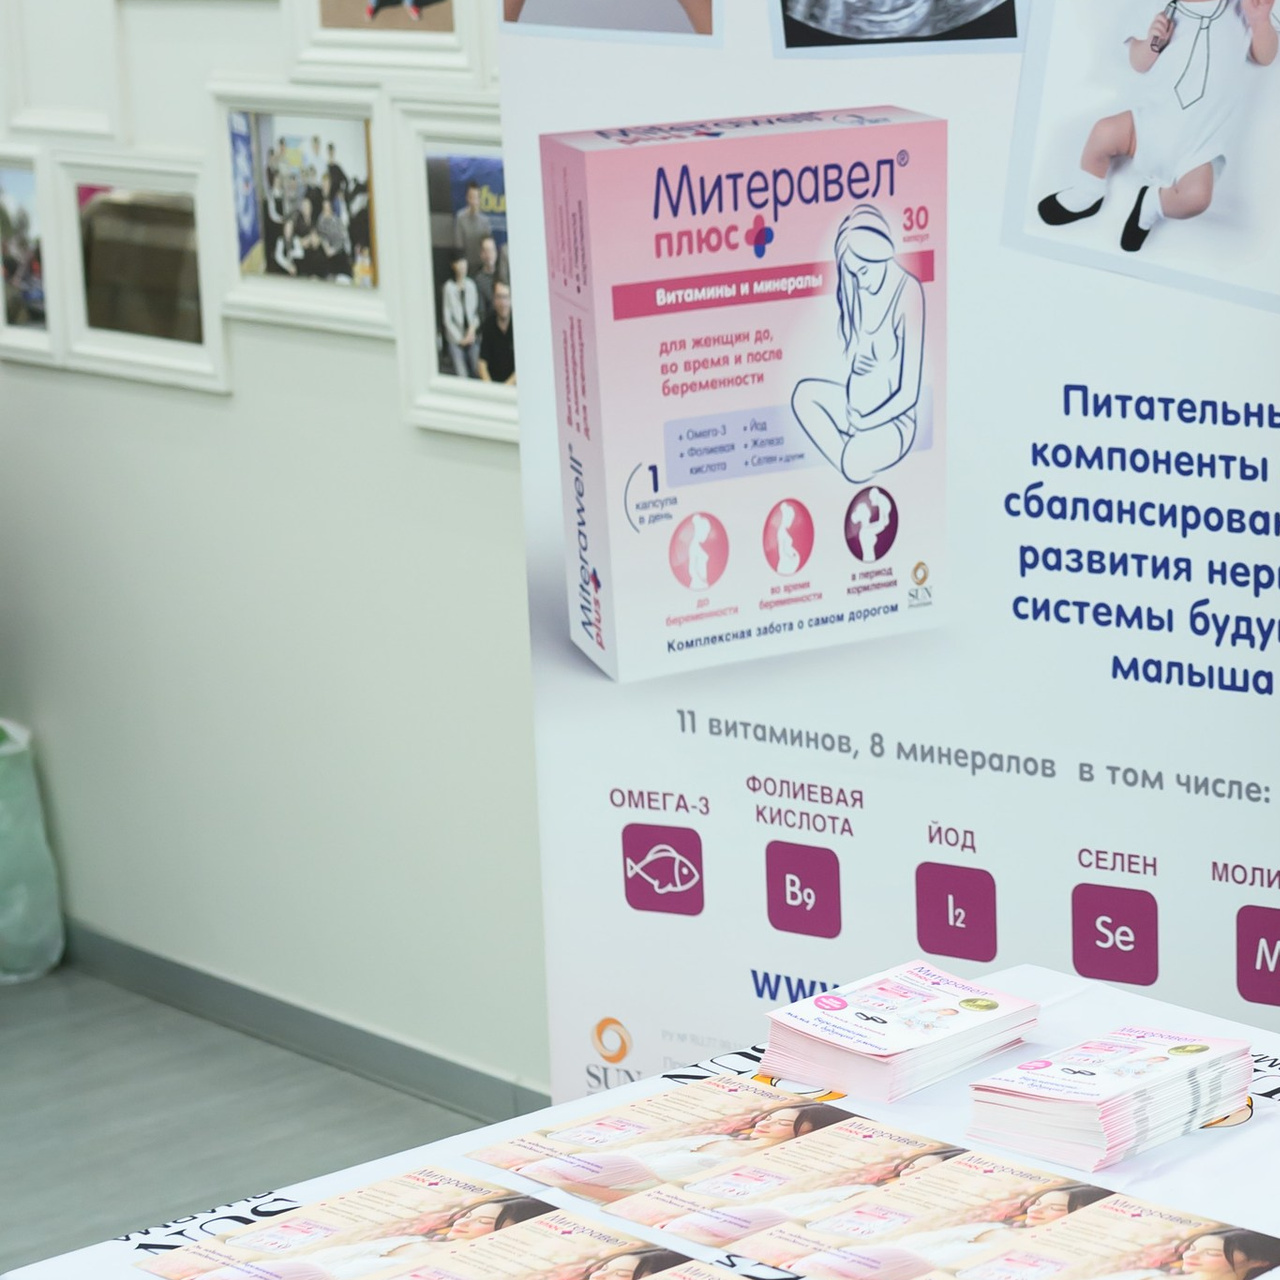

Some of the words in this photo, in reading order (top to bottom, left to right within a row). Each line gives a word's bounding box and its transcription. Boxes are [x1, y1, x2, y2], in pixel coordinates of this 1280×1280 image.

[902, 206, 929, 231] 30
[655, 224, 739, 258] плюс
[656, 283, 736, 307] Витамины
[740, 282, 749, 296] и
[753, 273, 822, 296] минералы
[659, 341, 686, 357] для
[692, 333, 750, 350] женщин
[754, 329, 774, 345] до,
[660, 361, 678, 375] во
[683, 356, 729, 375] время
[734, 354, 742, 365] и
[747, 348, 783, 364] после
[661, 376, 765, 398] беременности
[648, 464, 659, 493] 1
[1031, 442, 1268, 482] компоненты
[1020, 545, 1193, 582] развития
[667, 628, 751, 653] Комплексная
[756, 620, 793, 637] забота
[807, 613, 845, 628] самом
[848, 602, 898, 623] дорогом
[1013, 595, 1174, 632] системы
[1112, 656, 1275, 695] малыша
[676, 709, 697, 734] 11
[707, 715, 861, 760] витаминов,
[869, 732, 886, 758] 8
[896, 740, 1058, 779] минералов
[1078, 760, 1095, 783] в
[1106, 765, 1165, 792] том
[1175, 773, 1272, 806] числе:
[609, 788, 711, 816] ОМЕГА-3
[746, 775, 864, 810] ФОЛИЕВАЯ
[756, 804, 854, 838] КИСЛОТА
[928, 820, 977, 853] ЙОД
[1078, 848, 1159, 877] СЕЛЕН
[1095, 915, 1136, 952] Se
